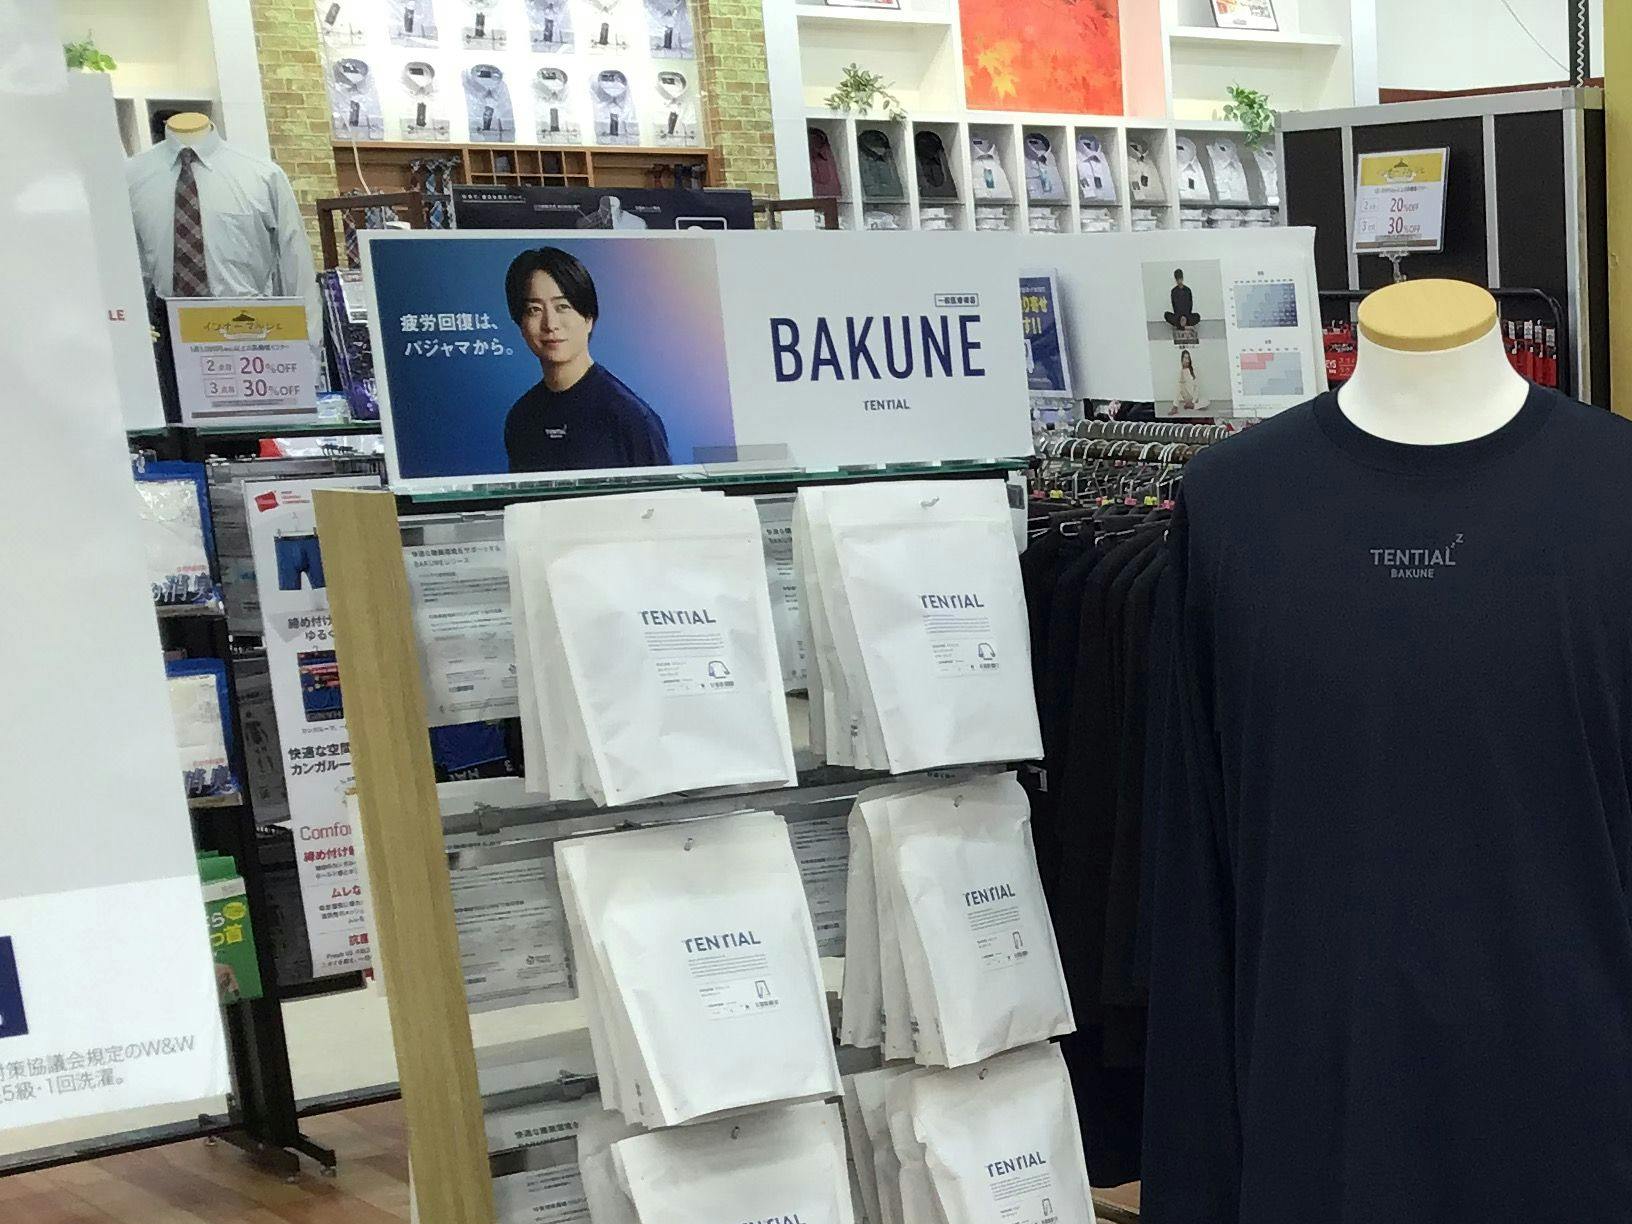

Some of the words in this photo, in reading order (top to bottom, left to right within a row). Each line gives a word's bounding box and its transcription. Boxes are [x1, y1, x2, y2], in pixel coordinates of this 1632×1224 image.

[400, 313, 499, 333] 疲労回復は、
[404, 337, 514, 358] パジャマから。
[770, 314, 986, 382] BAKUNE
[863, 399, 911, 411] TENTIAL
[1370, 546, 1456, 566] TENTIAL
[1391, 568, 1435, 579] BAKUNE
[918, 593, 984, 609] TENTIAL
[639, 609, 716, 625] TENTIAL
[963, 883, 1016, 907] TENTIAL
[682, 931, 762, 954] TENTIAL
[985, 1151, 1047, 1178] TENTIAL
